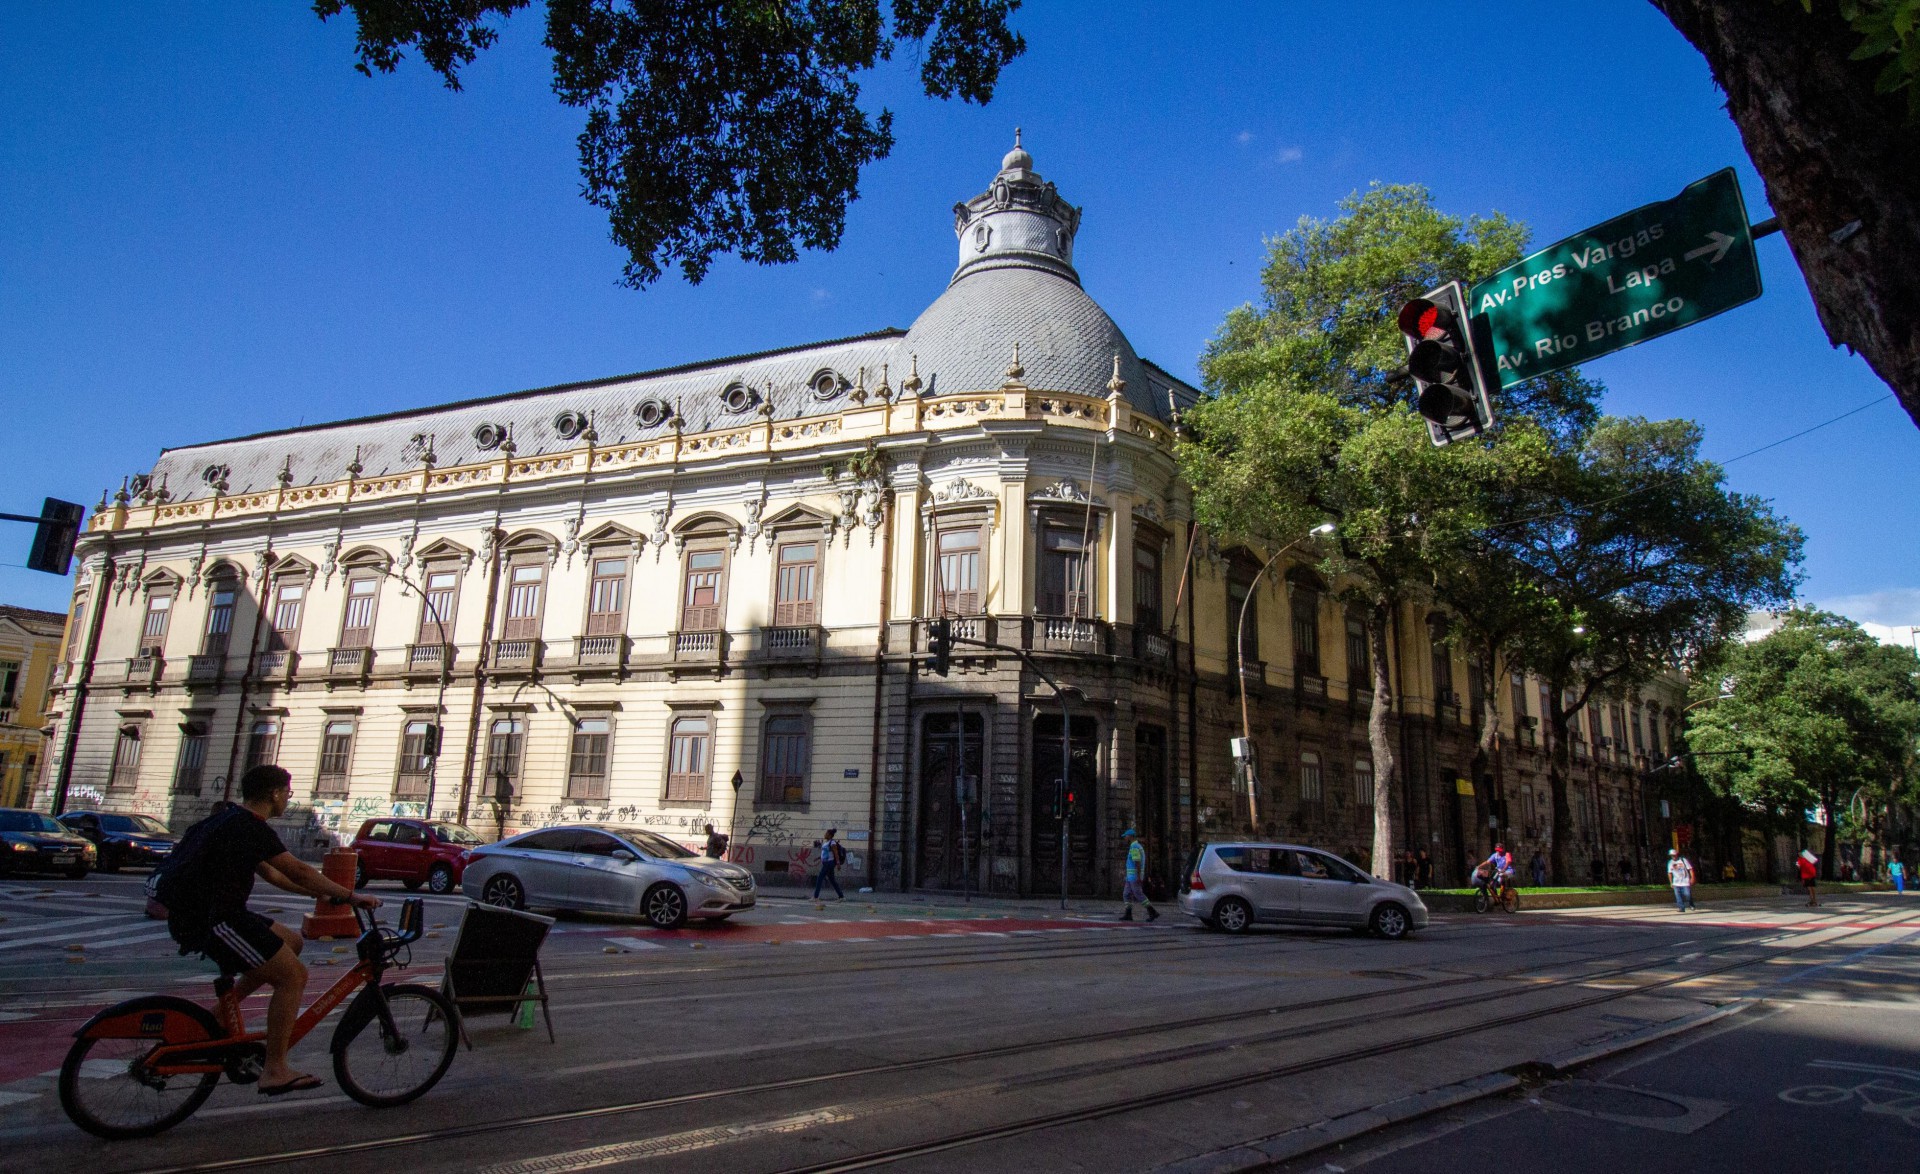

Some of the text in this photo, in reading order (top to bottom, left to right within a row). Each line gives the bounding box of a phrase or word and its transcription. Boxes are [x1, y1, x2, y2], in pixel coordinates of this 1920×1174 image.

[1606, 257, 1676, 295] Lapa
[1535, 334, 1578, 359] Rio
[1585, 297, 1684, 342] Branco
[312, 993, 336, 1015] bike
